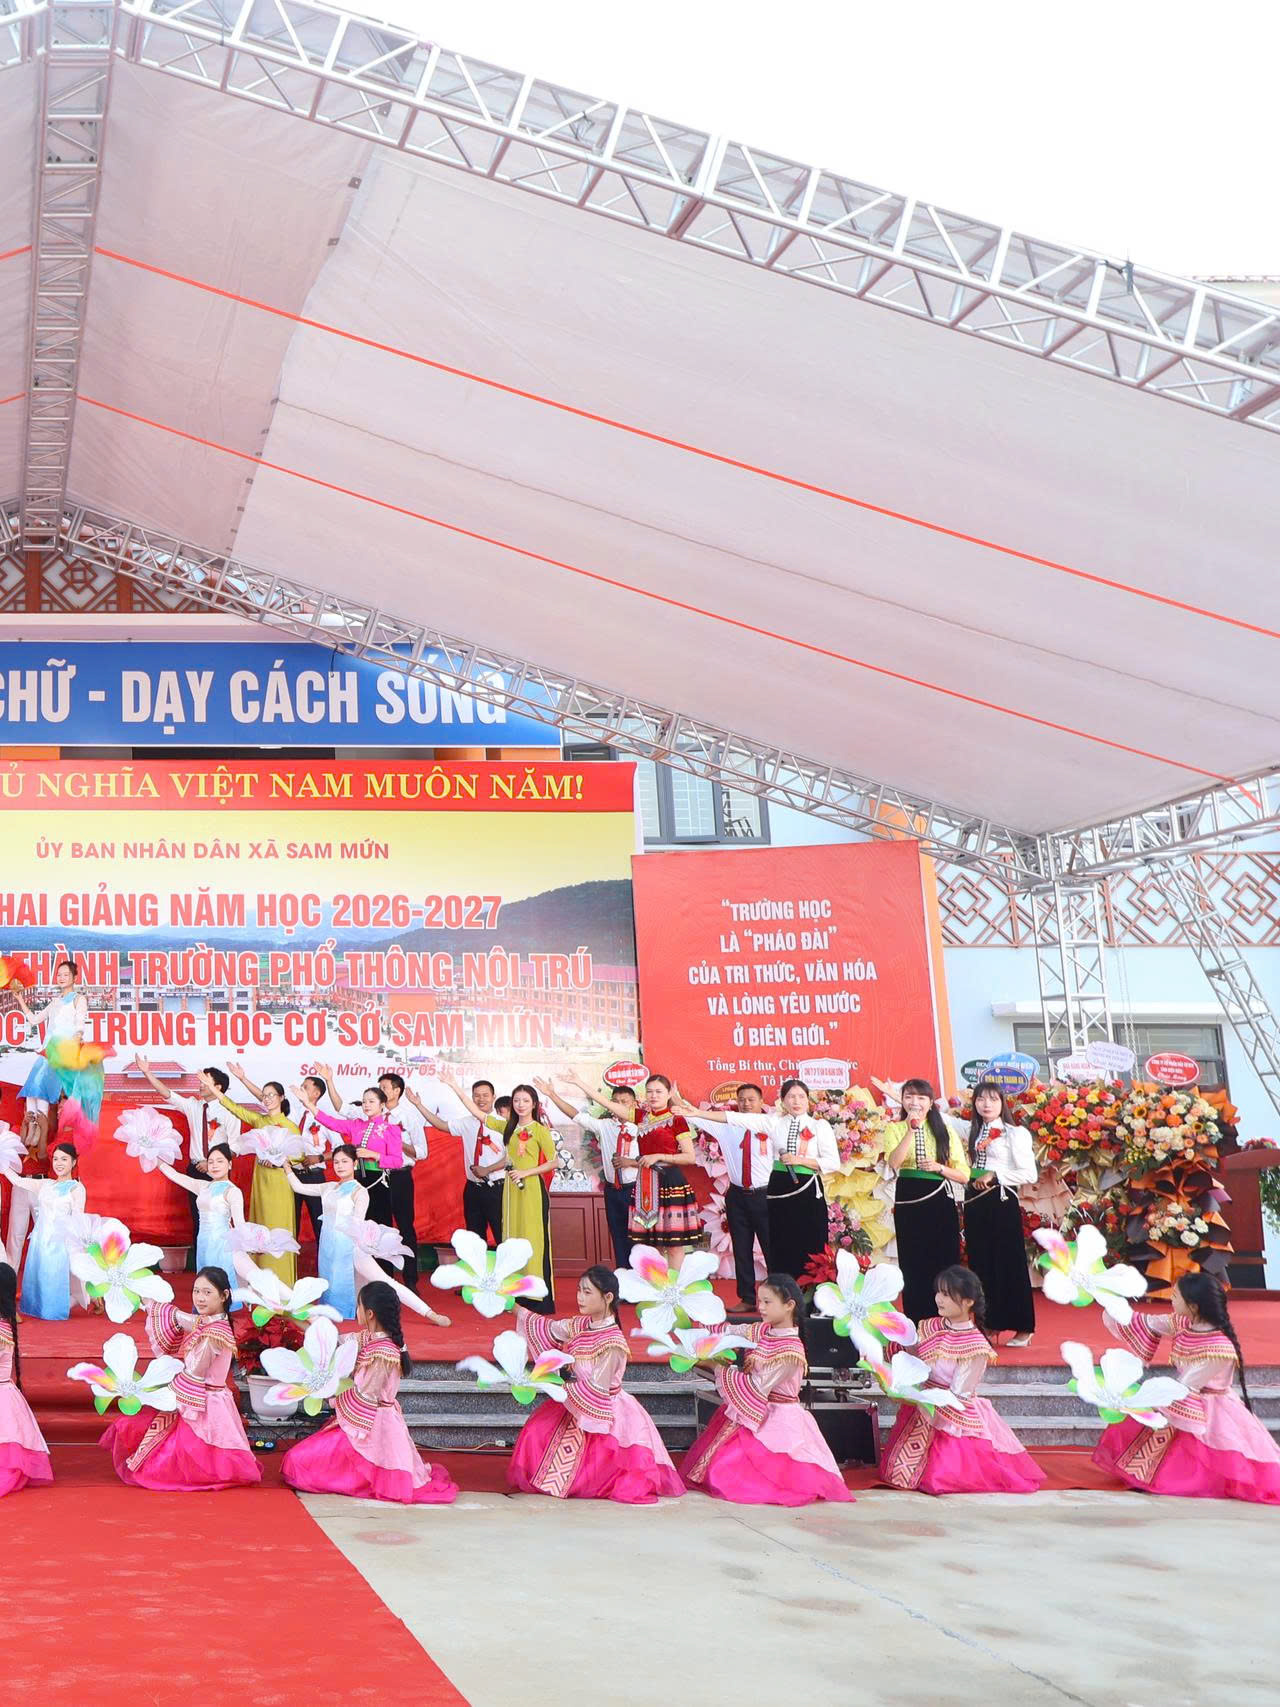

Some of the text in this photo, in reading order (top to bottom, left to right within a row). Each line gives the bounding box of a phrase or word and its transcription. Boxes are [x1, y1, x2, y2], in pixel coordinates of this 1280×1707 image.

[89, 690, 106, 702] -
[122, 671, 214, 735] DẠY
[230, 659, 359, 724] CÁCH
[376, 654, 507, 724] SỐNG
[39, 765, 160, 799] NGHĨA
[169, 765, 258, 805] VIỆT
[271, 772, 353, 798] NAM
[364, 765, 479, 799] MUÔN
[490, 767, 584, 800] NĂM!
[36, 835, 389, 860] ỦY BAN NHÂN DÂN XÃ SAM MỨN
[60, 882, 163, 929] GIẢNG
[171, 886, 245, 928] NĂM
[256, 894, 321, 935] HỌC
[332, 895, 502, 930] 2026-2027
[799, 900, 831, 923] HỌC
[720, 931, 740, 953] LÀ
[128, 942, 258, 988] TRƯỜNG
[270, 937, 335, 988] PHỔ
[346, 943, 453, 989] THÔNG
[464, 943, 521, 997] NỘI
[530, 945, 592, 990] TRÚ
[688, 957, 877, 985] CỦA TRI THỨC, VĂN HÓA
[707, 990, 861, 1016] VÀ LÒNG YÊU NƯỚC
[88, 1011, 196, 1047] TRUNG
[207, 1011, 273, 1055] HỌC
[283, 1008, 328, 1047] CƠ
[337, 1000, 384, 1048] SỞ
[393, 1012, 465, 1048] SAM
[475, 1006, 553, 1048] MỨN
[733, 1022, 744, 1047] Ở
[748, 1024, 787, 1046] BIÊN
[300, 1063, 318, 1077] Sa
[337, 1062, 372, 1078] Mứn,
[707, 1056, 737, 1073] Tổng
[739, 1059, 752, 1071] Bí
